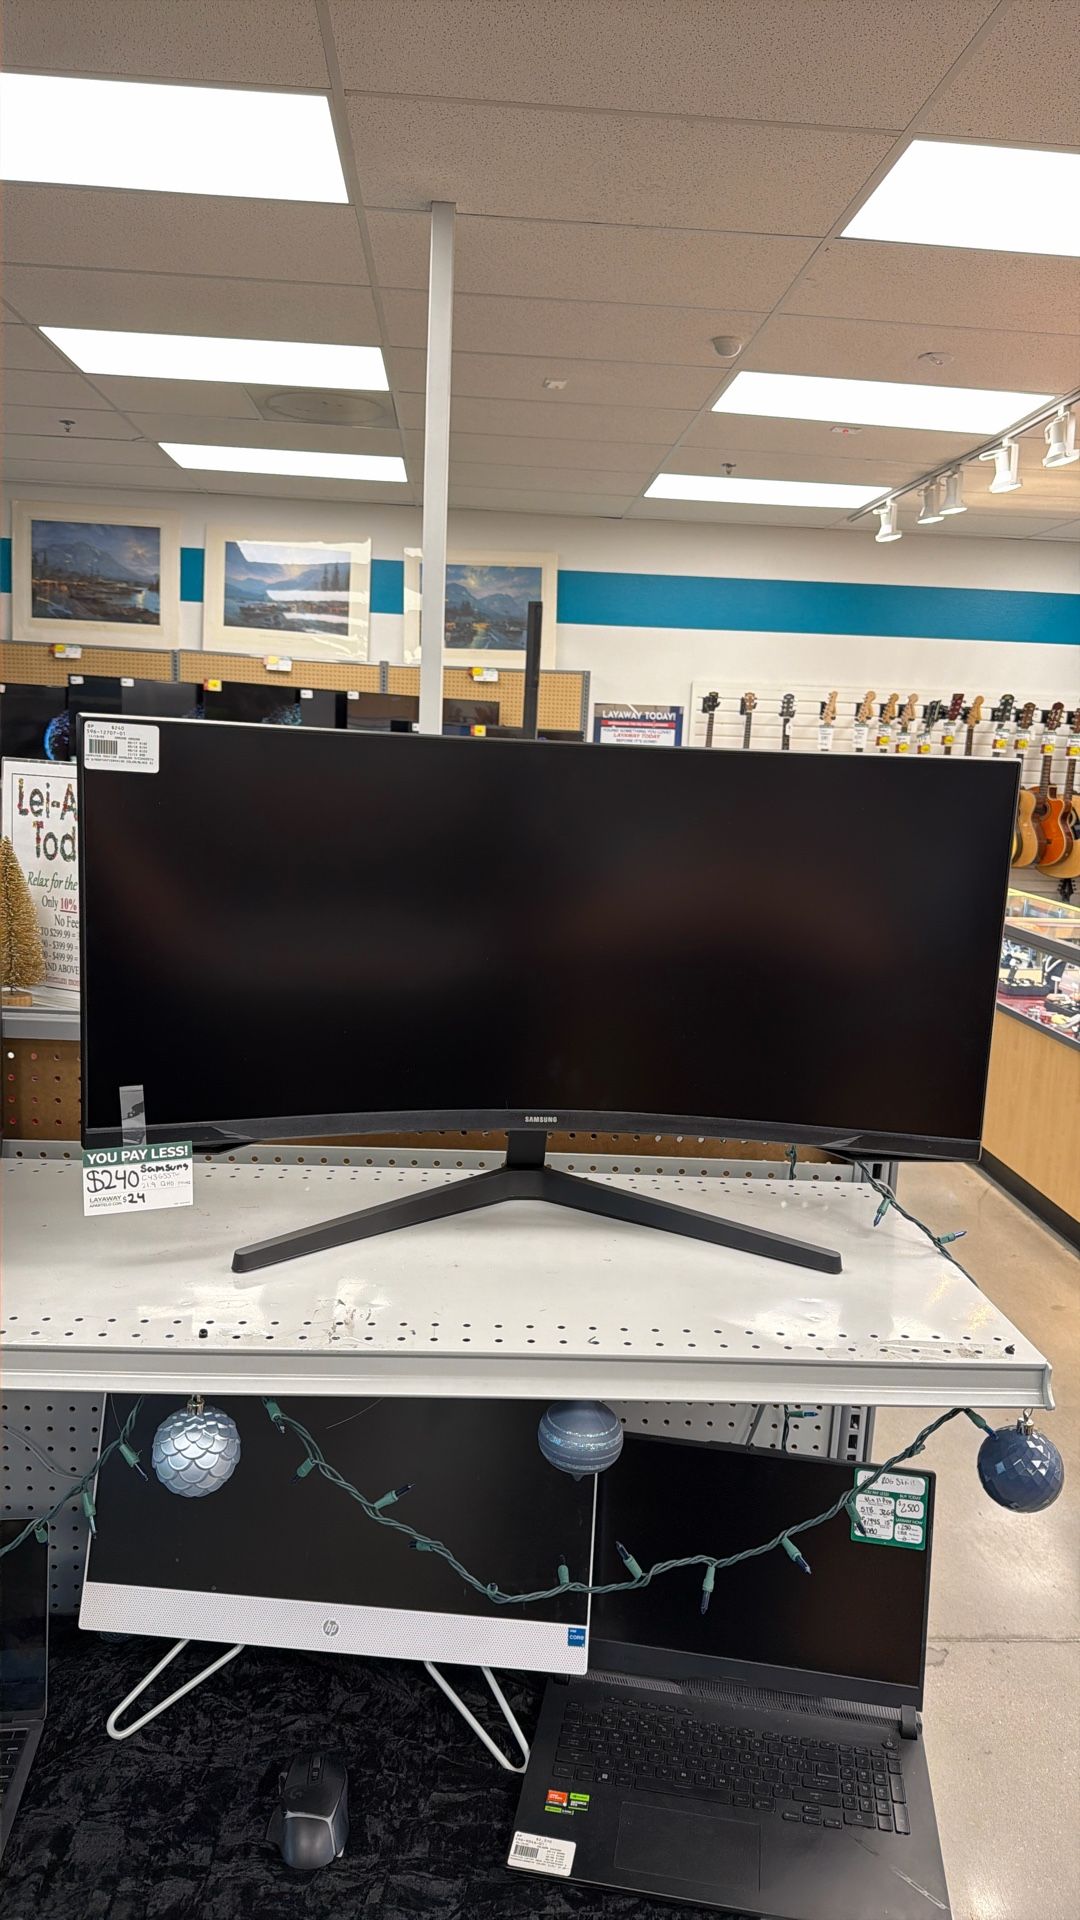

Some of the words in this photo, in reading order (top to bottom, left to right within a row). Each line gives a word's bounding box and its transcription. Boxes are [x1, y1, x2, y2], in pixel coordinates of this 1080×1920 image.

[602, 710, 642, 720] LAYAWAY
[645, 711, 677, 721] TODAY!
[17, 777, 78, 821] Lei-A
[32, 820, 77, 863] Tod
[27, 870, 48, 888] Relax
[47, 871, 62, 893] for
[64, 874, 79, 891] the
[41, 895, 59, 910] Only
[60, 897, 78, 912] 10%
[54, 914, 65, 927] No
[49, 928, 71, 939] $299.99
[52, 940, 74, 951] $399.99
[52, 951, 74, 962] $499.99
[58, 963, 79, 975] ABOVE
[87, 1151, 117, 1165] YOU
[121, 1149, 147, 1163] PAY
[151, 1145, 188, 1159] LESS!
[86, 1169, 140, 1193] $240
[140, 1162, 189, 1173] Samsung
[89, 1195, 121, 1203] LAYAWAY
[122, 1192, 146, 1204] $24
[323, 1620, 339, 1637] hp
